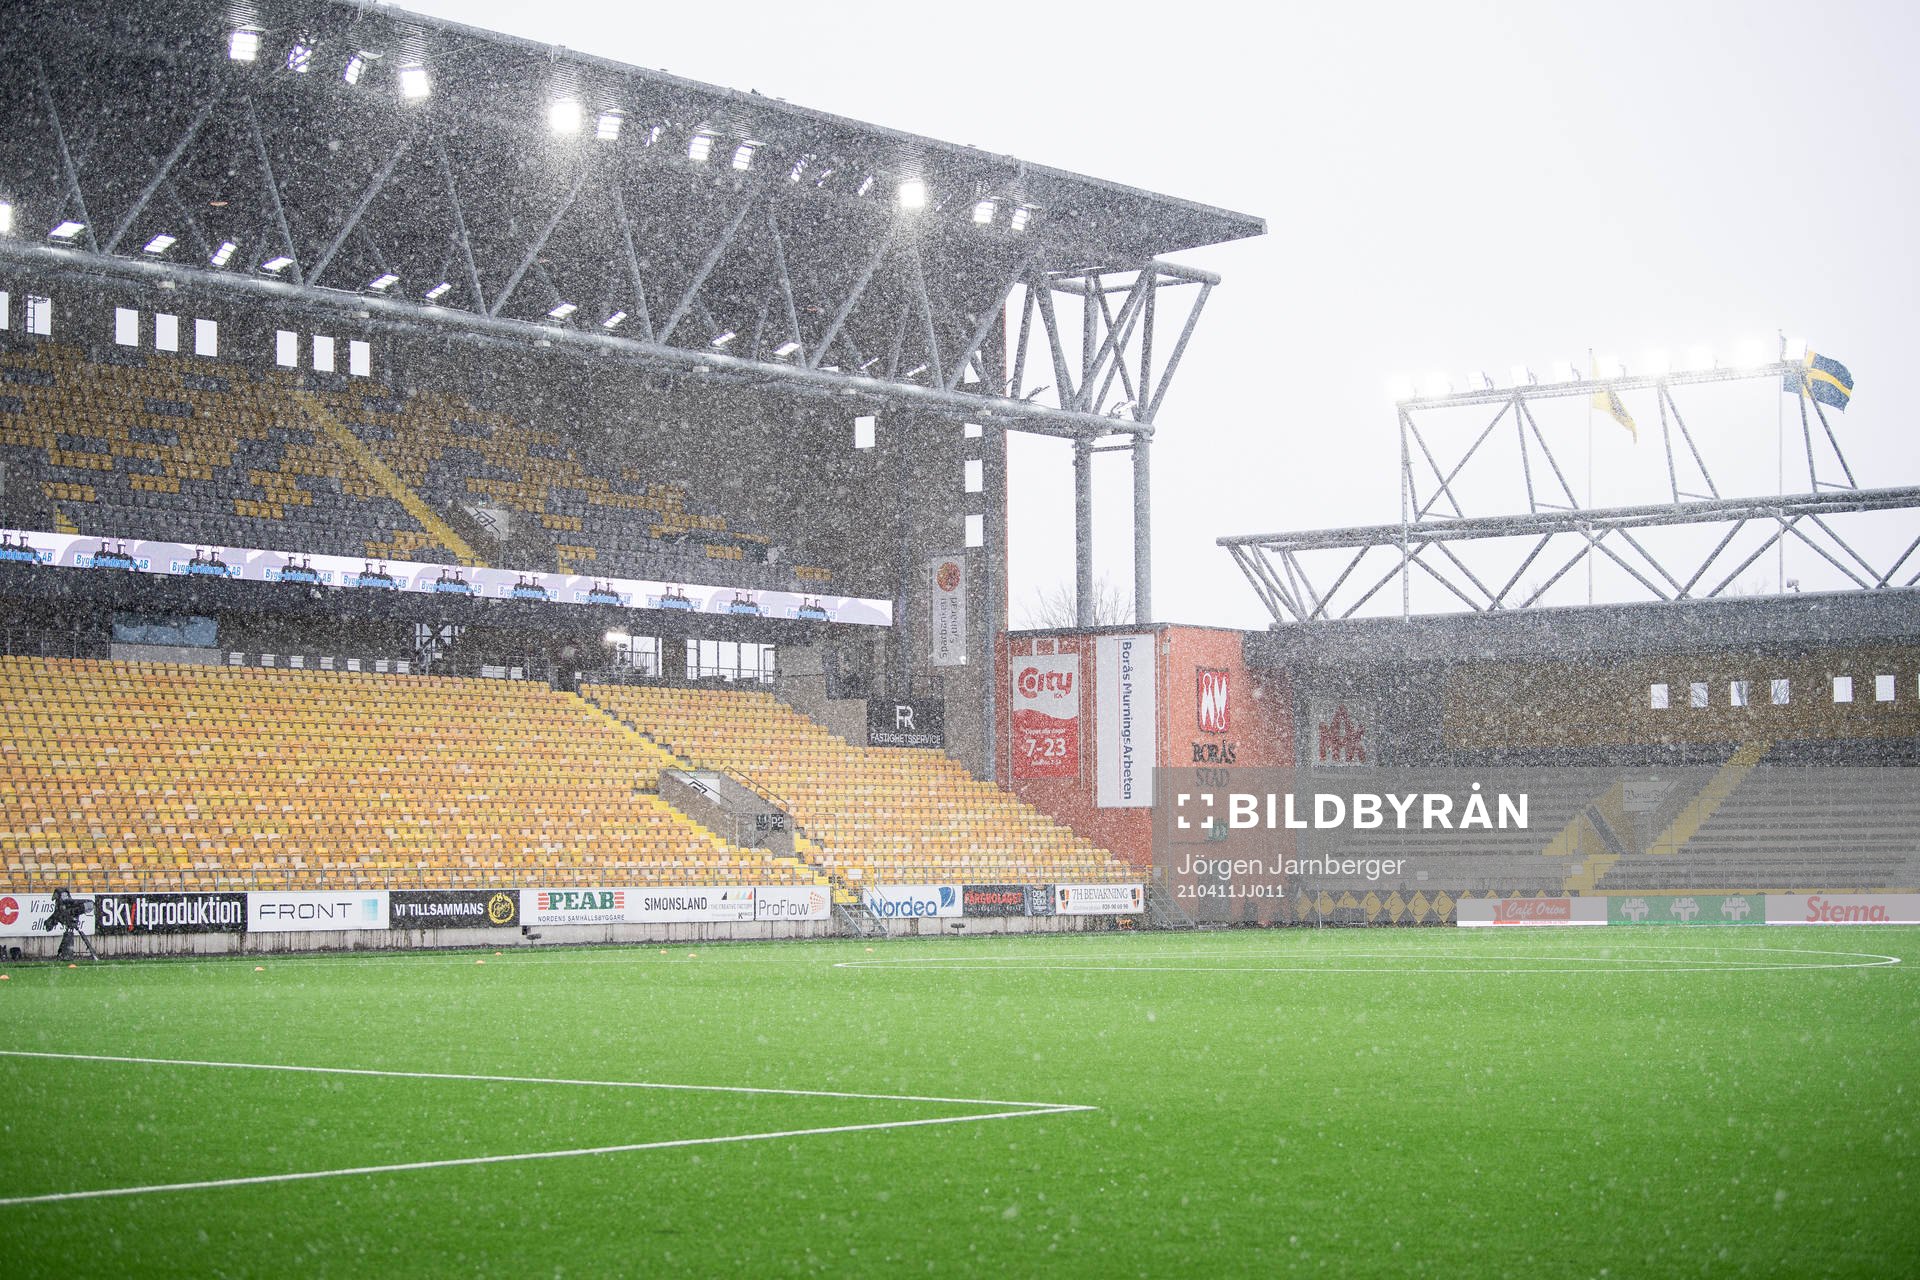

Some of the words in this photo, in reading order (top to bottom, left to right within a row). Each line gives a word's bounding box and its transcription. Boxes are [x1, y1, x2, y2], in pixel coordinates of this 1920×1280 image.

[43, 551, 53, 562] AB
[138, 559, 149, 570] AB
[231, 566, 241, 577] AB
[322, 572, 332, 583] AB
[1121, 641, 1135, 681] Borås
[1025, 737, 1067, 758] 7-23
[1192, 740, 1237, 764] BORÅS
[30, 900, 39, 913] Vi
[547, 891, 615, 910] PEAB
[644, 896, 708, 911] SIMONSLAND
[758, 899, 809, 916] ProFlow
[869, 896, 937, 918] Nordea
[102, 896, 242, 932] Skyltproduktion
[259, 902, 353, 920] FRONT
[395, 903, 407, 917] VI
[409, 902, 484, 917] TILLSAMMANS
[538, 914, 566, 922] NORDENS
[1506, 901, 1535, 919] Café
[1535, 901, 1566, 916] Orion
